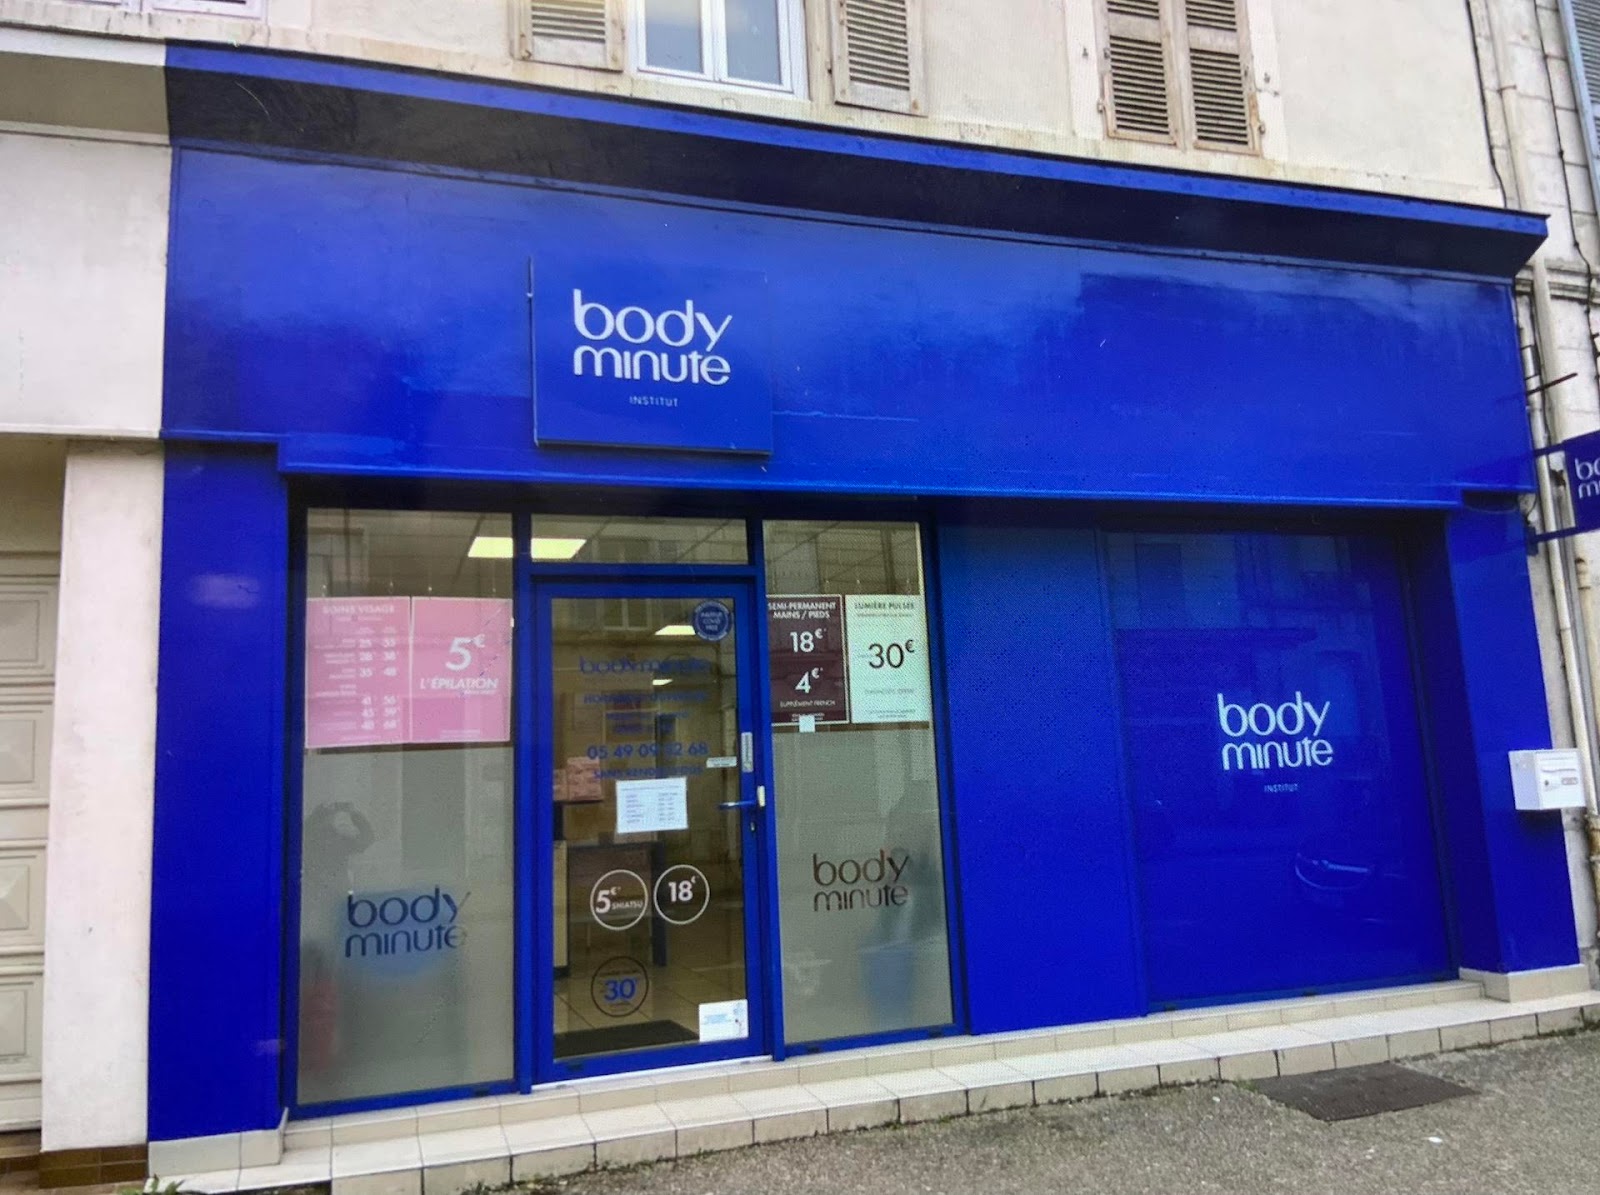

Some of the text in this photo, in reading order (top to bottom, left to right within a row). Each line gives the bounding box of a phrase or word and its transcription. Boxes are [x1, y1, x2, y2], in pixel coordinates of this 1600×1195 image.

[573, 288, 733, 352] body
[573, 345, 731, 385] minute
[629, 396, 679, 407] INSTITUT
[1217, 691, 1330, 737] body
[614, 744, 633, 758] 49
[1221, 737, 1334, 771] minute
[1264, 784, 1299, 793] INSTITUT
[813, 849, 909, 887] body
[348, 886, 471, 928] body
[814, 884, 908, 912] minute
[345, 925, 467, 958] minute
